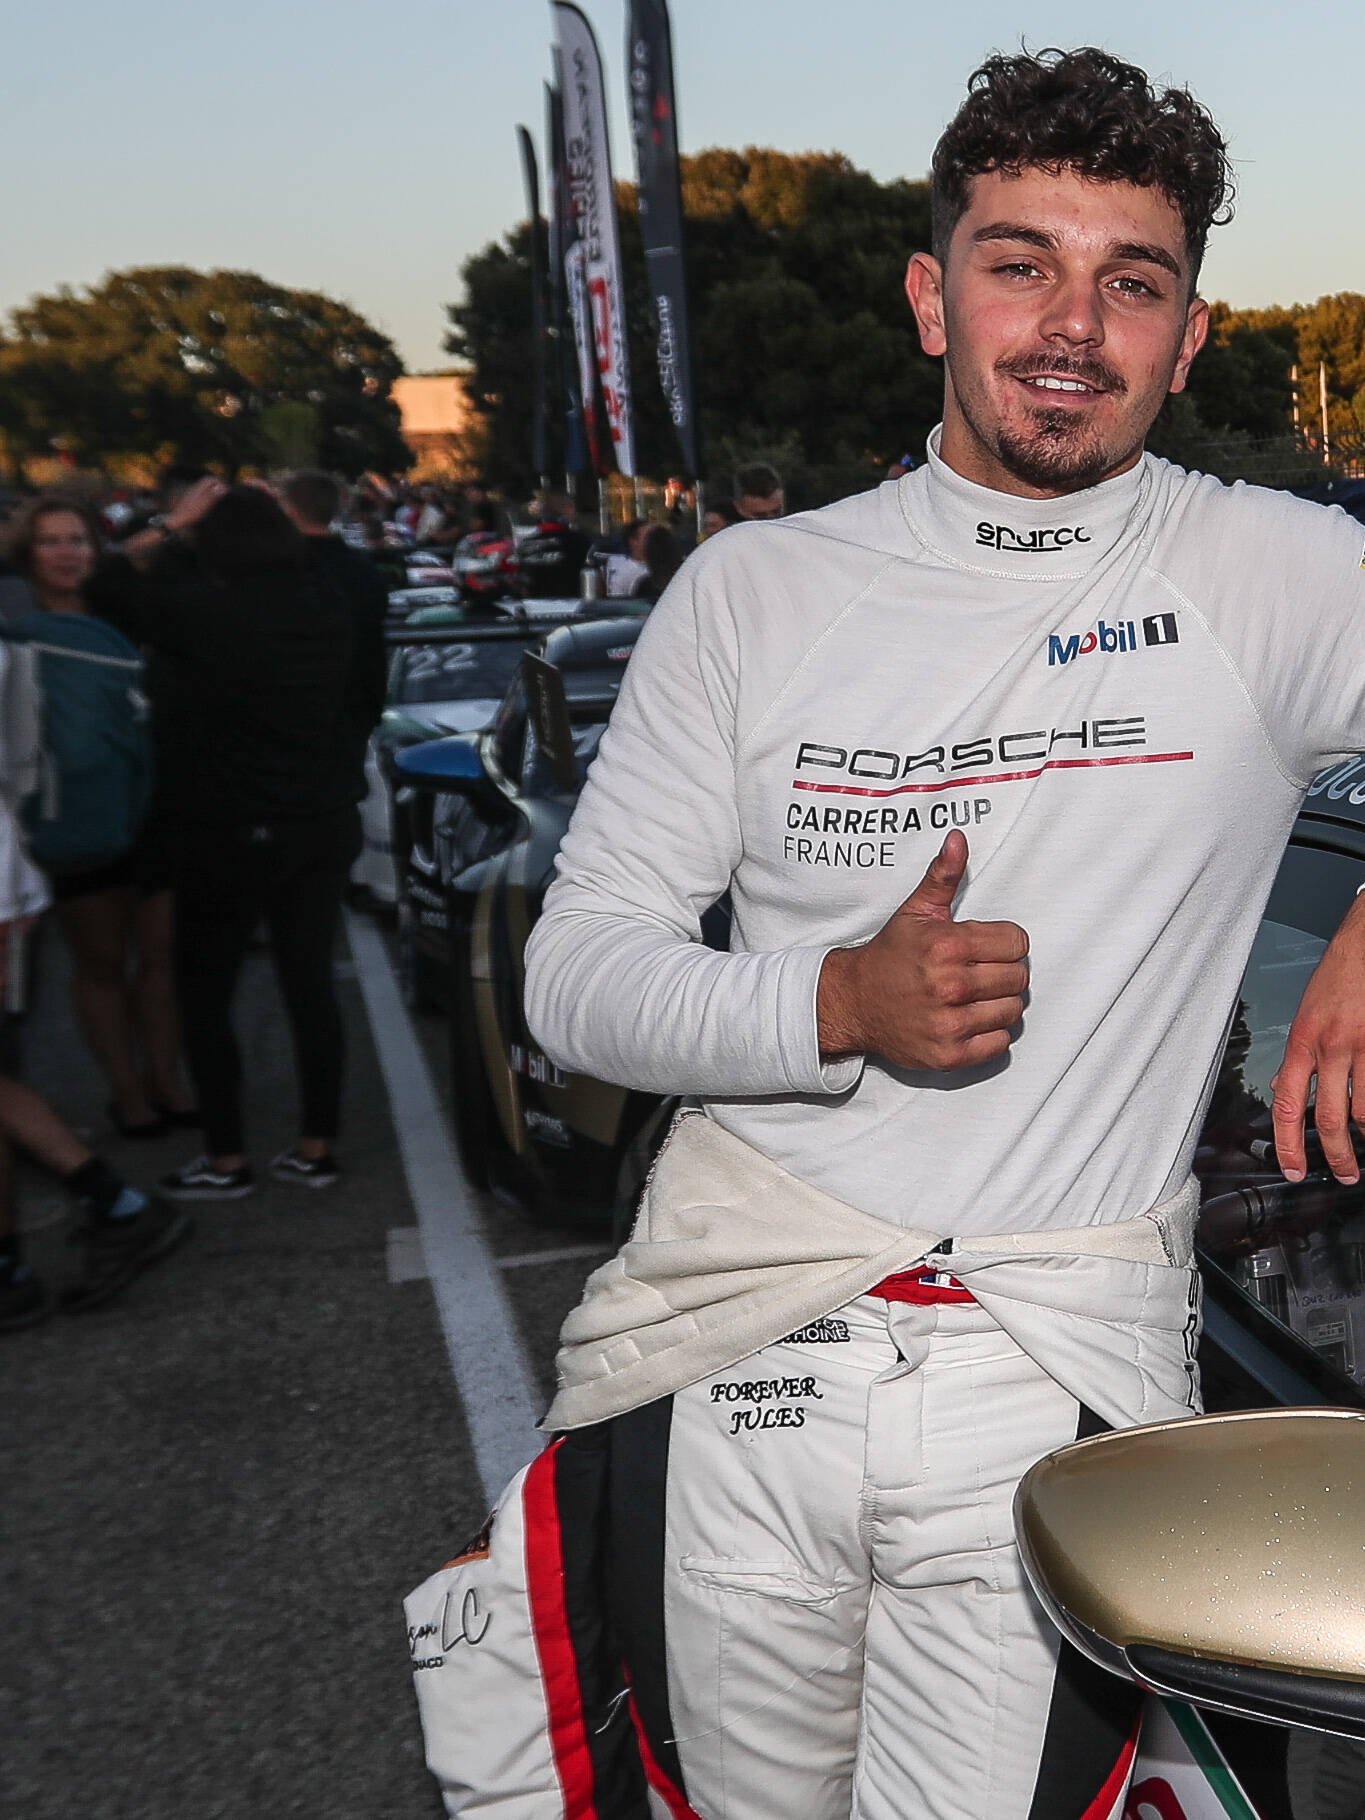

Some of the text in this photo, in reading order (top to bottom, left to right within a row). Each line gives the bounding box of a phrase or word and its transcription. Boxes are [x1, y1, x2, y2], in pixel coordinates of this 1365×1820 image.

[1048, 620, 1137, 666] Mobil
[796, 717, 1146, 780] PORSCHE
[787, 799, 992, 834] CARRERA CUP
[783, 835, 895, 868] FRANCE
[710, 1376, 824, 1404] FOREVER
[729, 1407, 806, 1436] JULES
